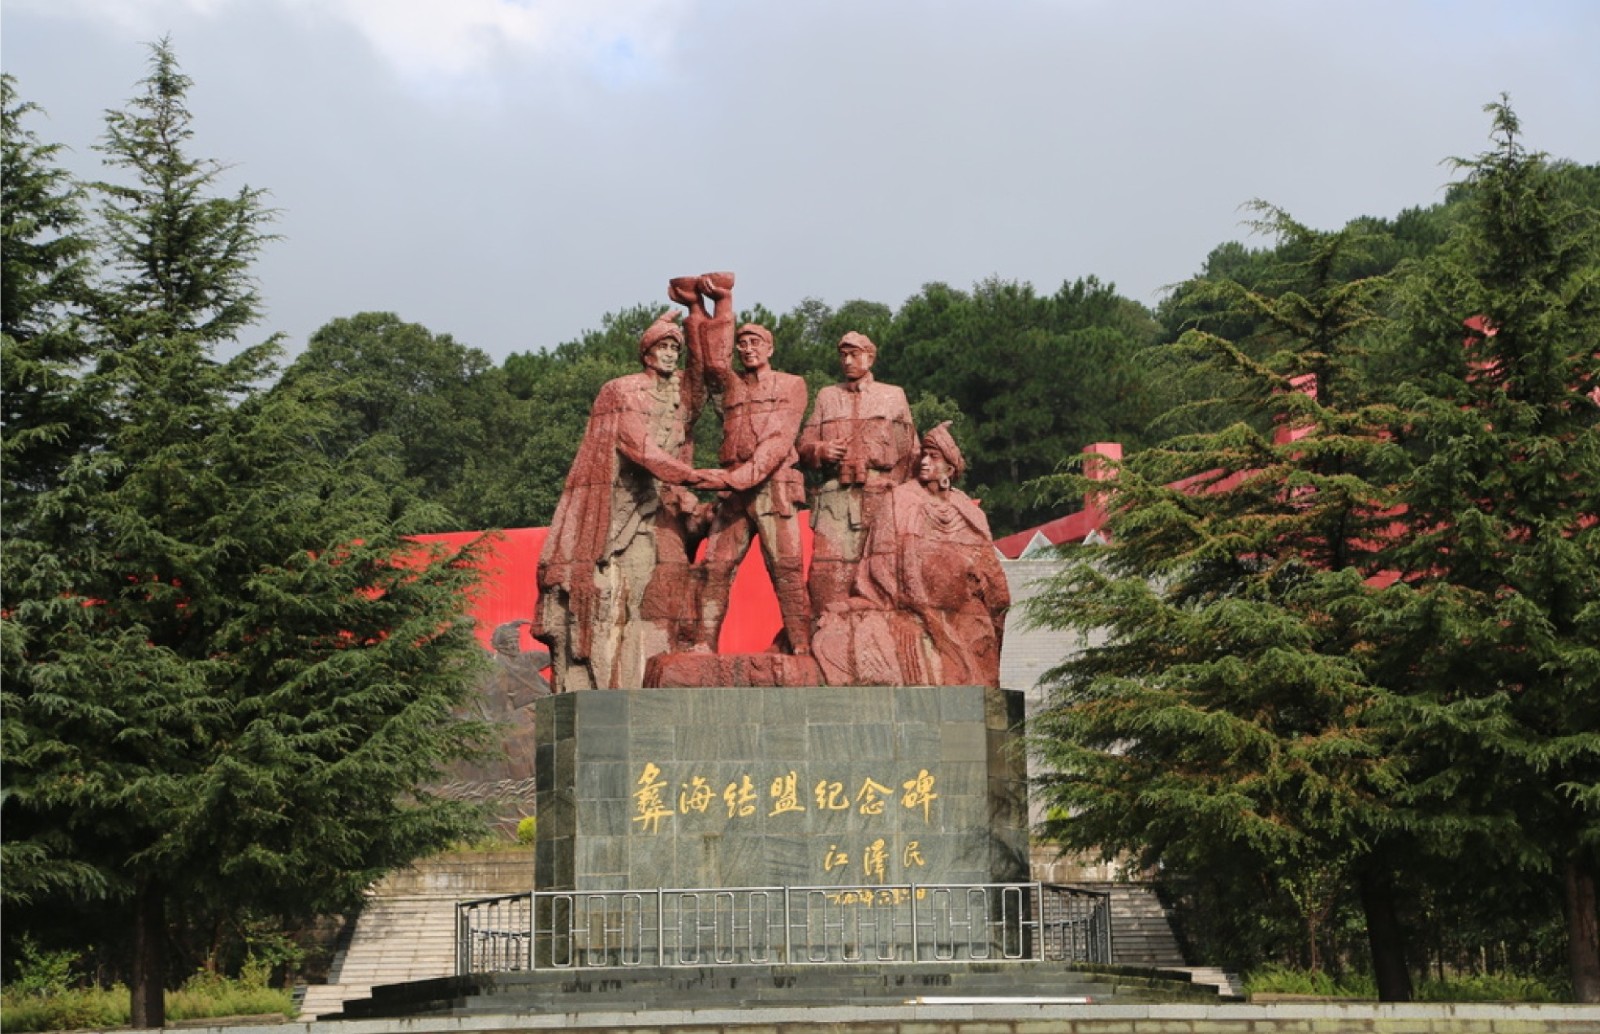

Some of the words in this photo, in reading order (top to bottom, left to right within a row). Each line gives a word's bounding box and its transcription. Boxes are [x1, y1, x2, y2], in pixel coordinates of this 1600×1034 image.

[632, 762, 939, 834] 彝海结盟纪念碑
